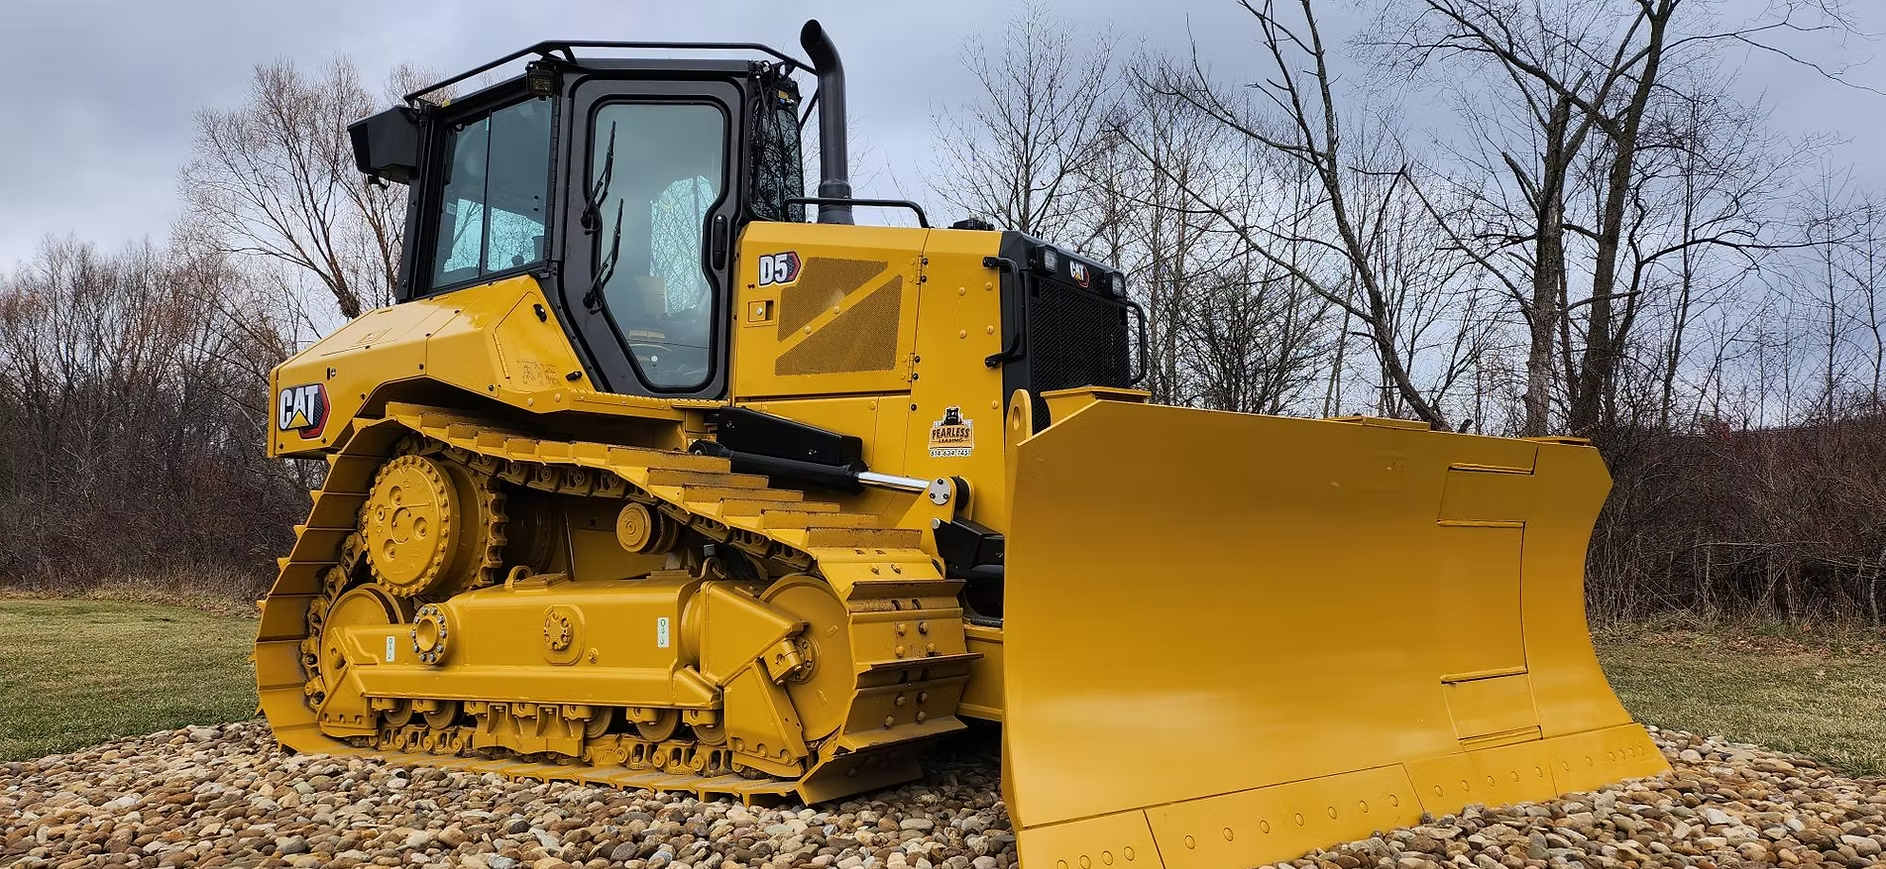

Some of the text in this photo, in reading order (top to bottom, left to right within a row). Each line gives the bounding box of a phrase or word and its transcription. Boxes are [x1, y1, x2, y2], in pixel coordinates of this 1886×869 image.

[760, 253, 788, 284] D5
[280, 384, 319, 430] CAT
[932, 427, 970, 440] FEARLESS
